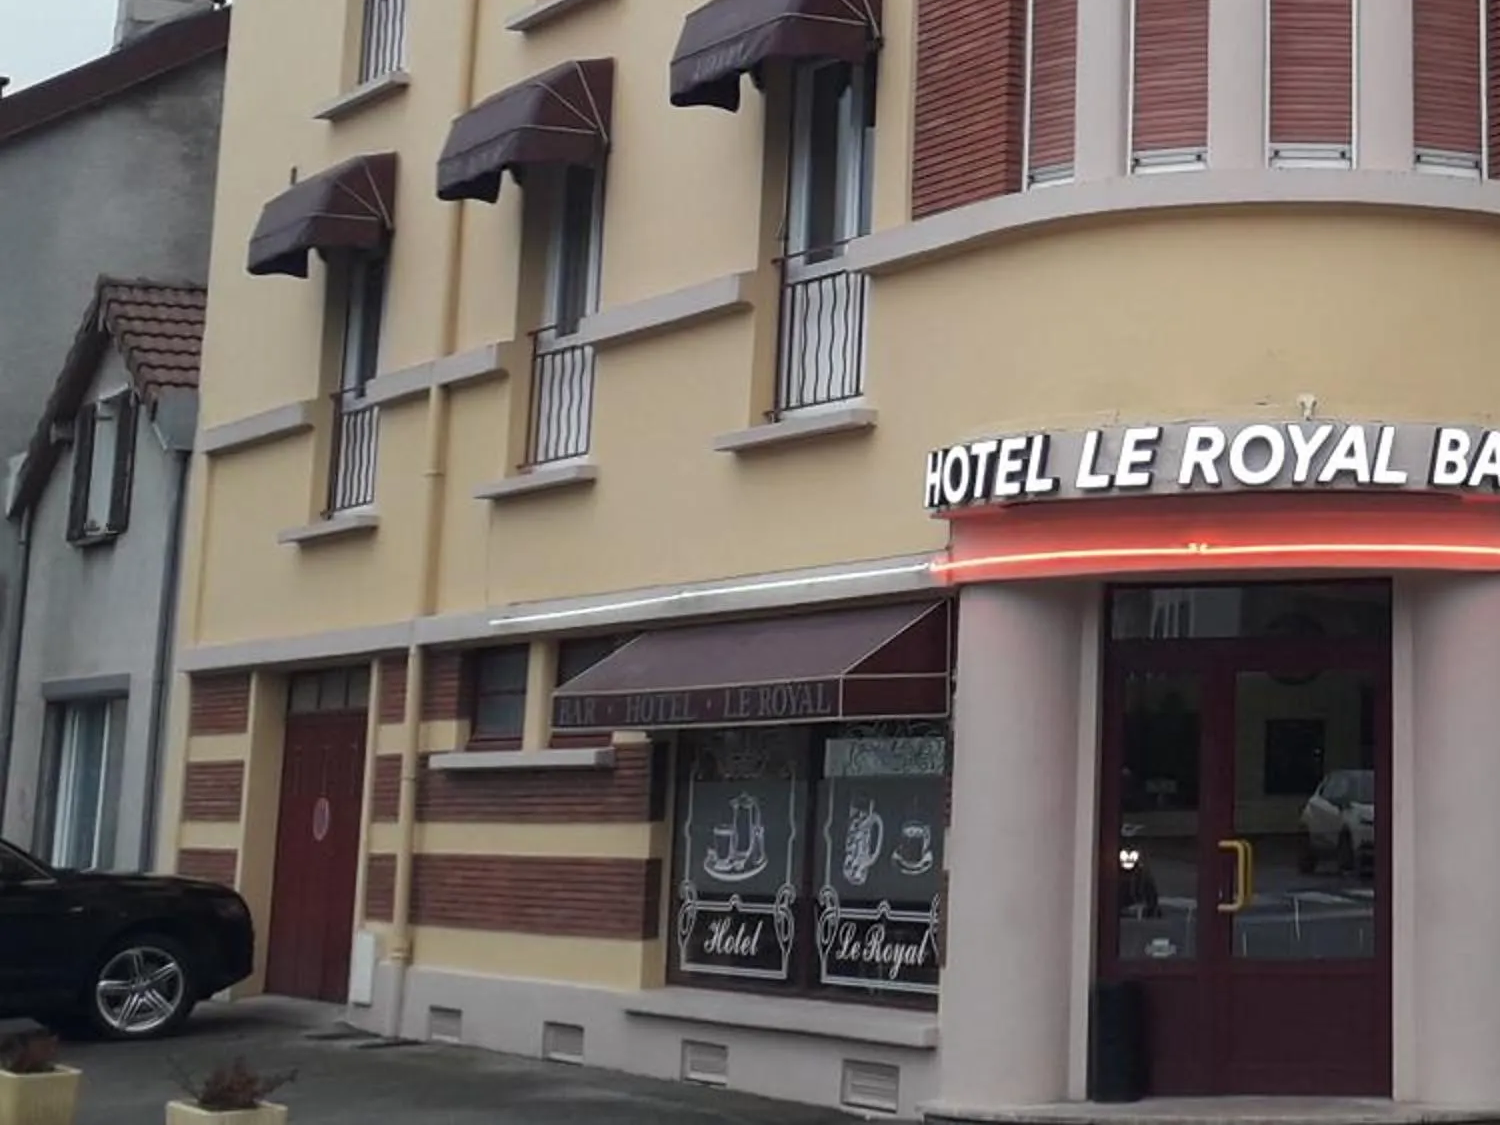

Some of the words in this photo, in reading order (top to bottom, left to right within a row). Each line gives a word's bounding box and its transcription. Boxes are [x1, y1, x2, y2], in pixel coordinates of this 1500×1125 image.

[924, 434, 1061, 508] HOTEL
[1075, 426, 1161, 490] LE
[1177, 425, 1409, 486] ROYAL
[559, 696, 598, 725] BAR
[624, 691, 698, 724] HOTEL
[723, 686, 753, 719] LE
[757, 682, 832, 717] ROYAL
[704, 916, 763, 957] Hotel
[836, 921, 861, 961] Le
[862, 923, 931, 980] Royal
